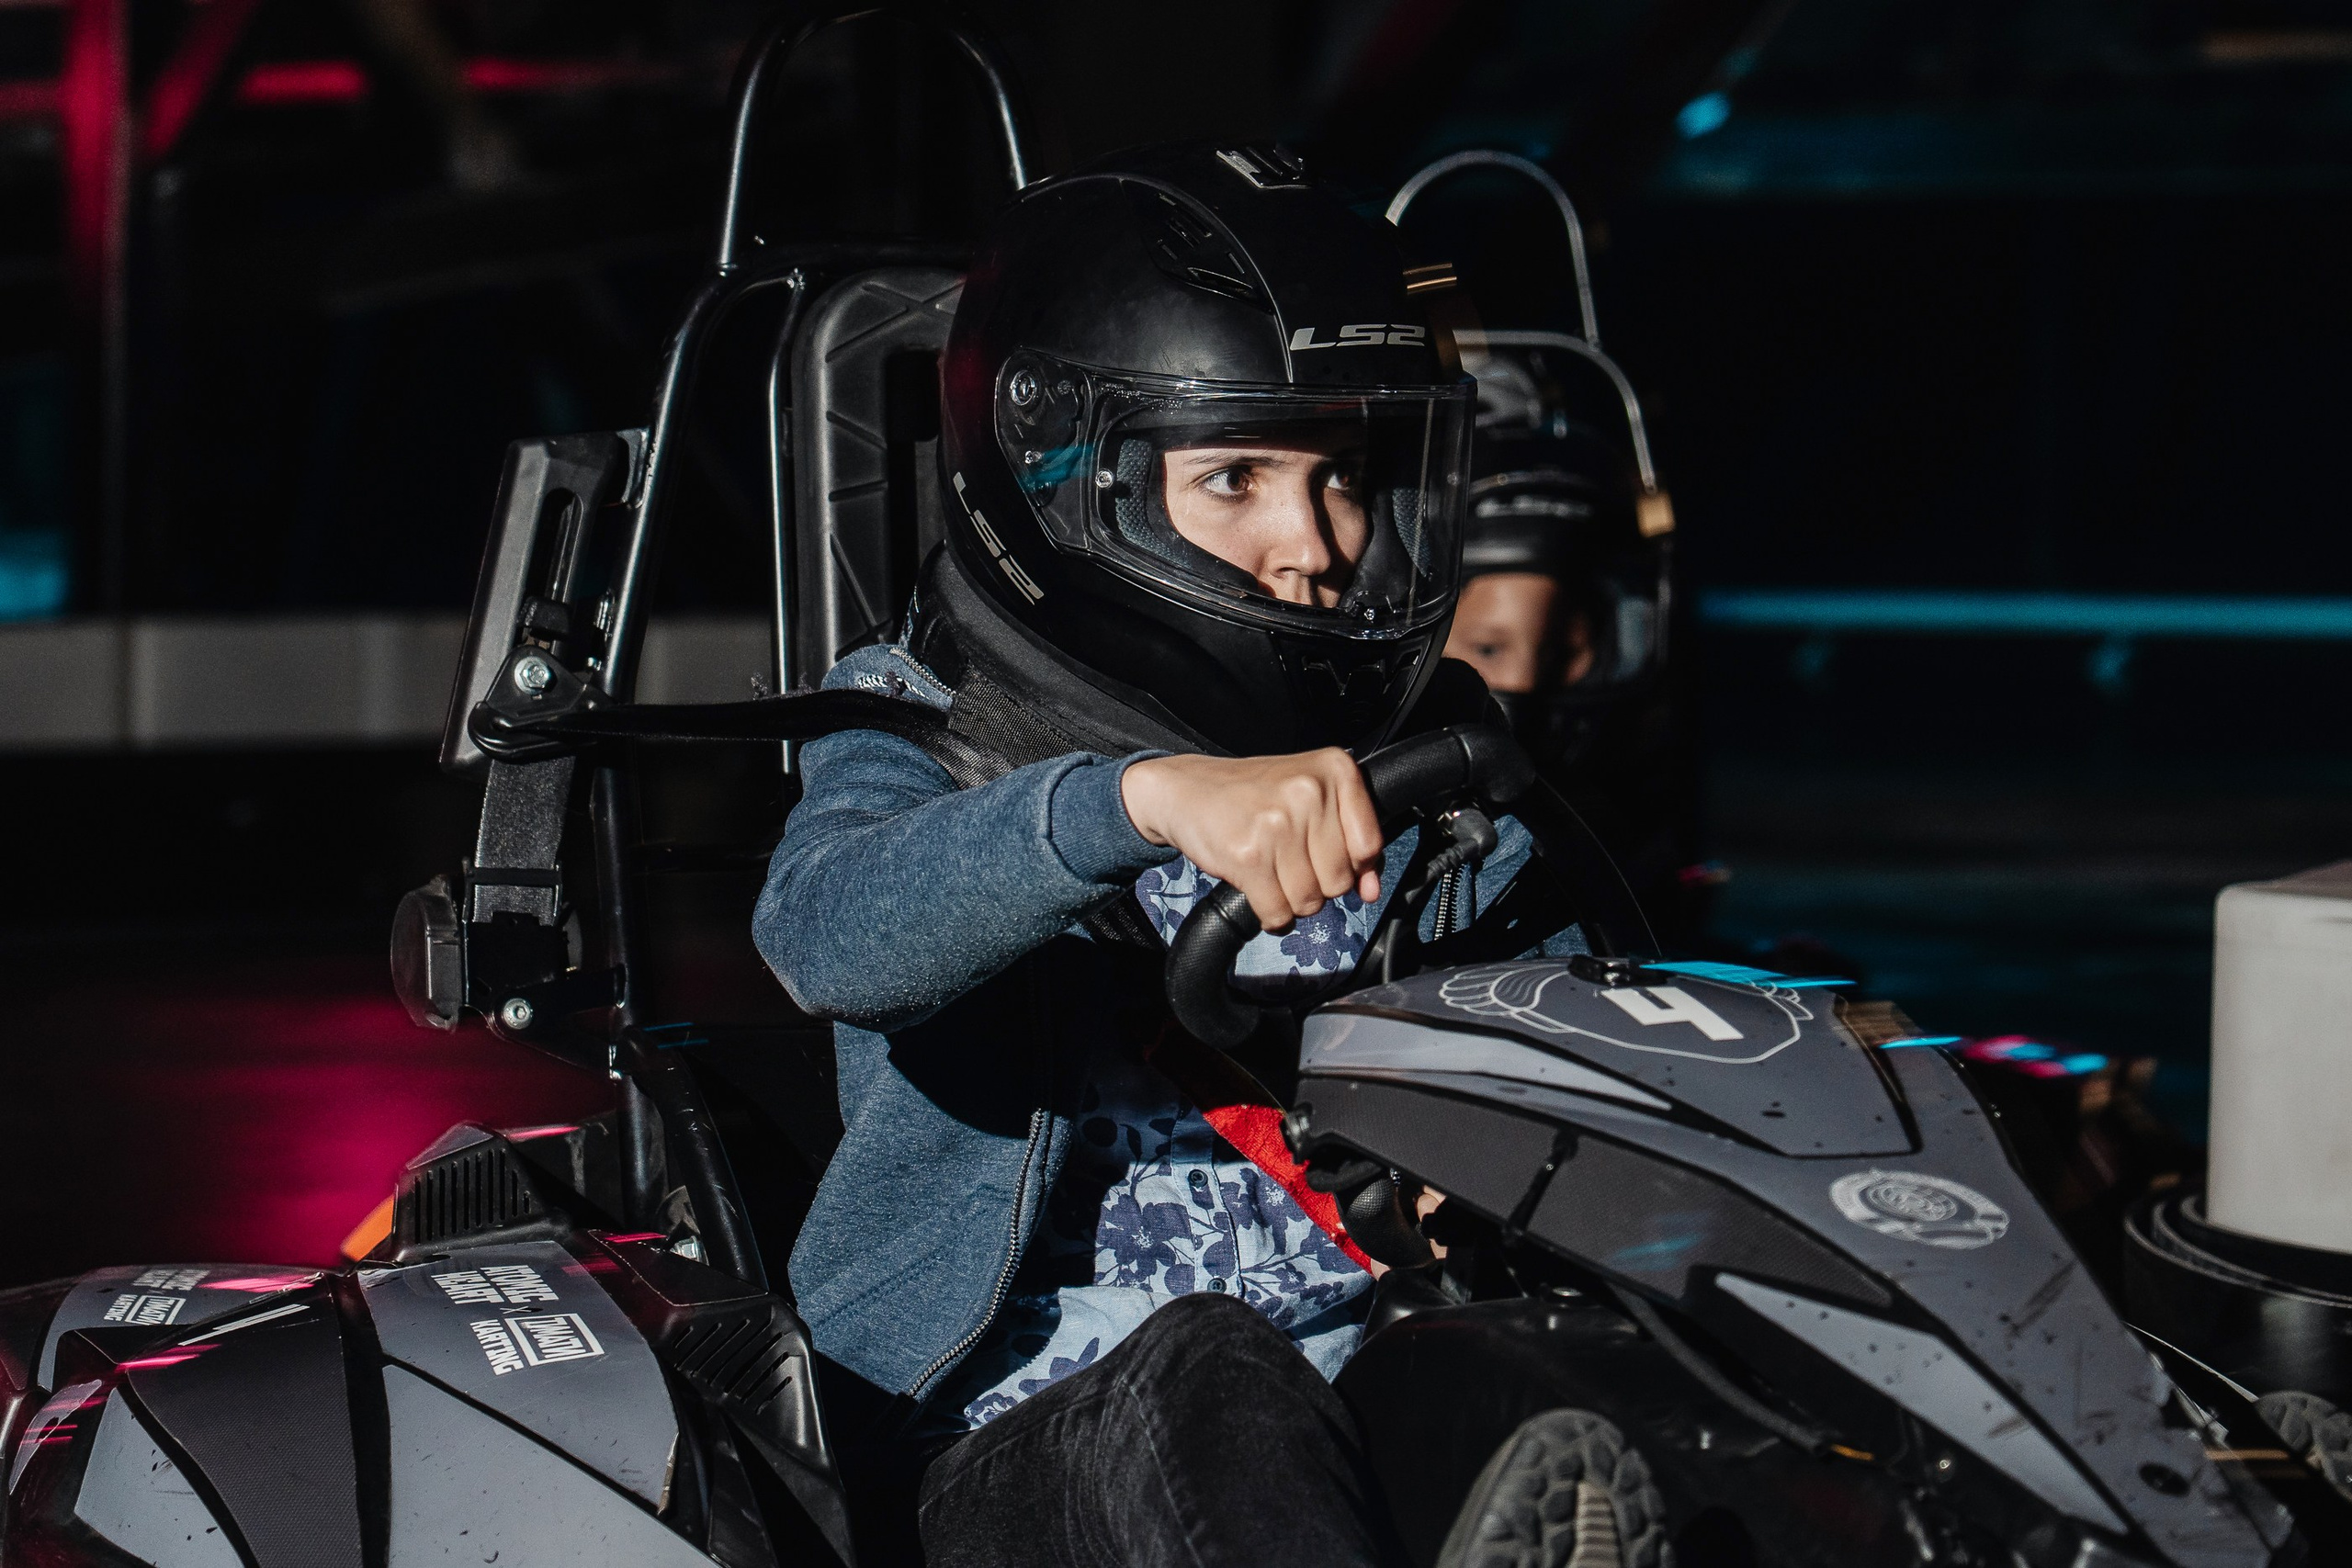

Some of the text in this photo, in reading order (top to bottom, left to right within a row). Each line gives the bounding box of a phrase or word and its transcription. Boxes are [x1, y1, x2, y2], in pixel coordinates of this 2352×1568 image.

[1289, 324, 1426, 352] LS2
[953, 471, 1045, 605] LS2
[1600, 986, 1744, 1041] 4
[431, 1270, 504, 1304] HEART
[480, 1265, 559, 1303] ATOMIC
[469, 1319, 524, 1376] KARTING
